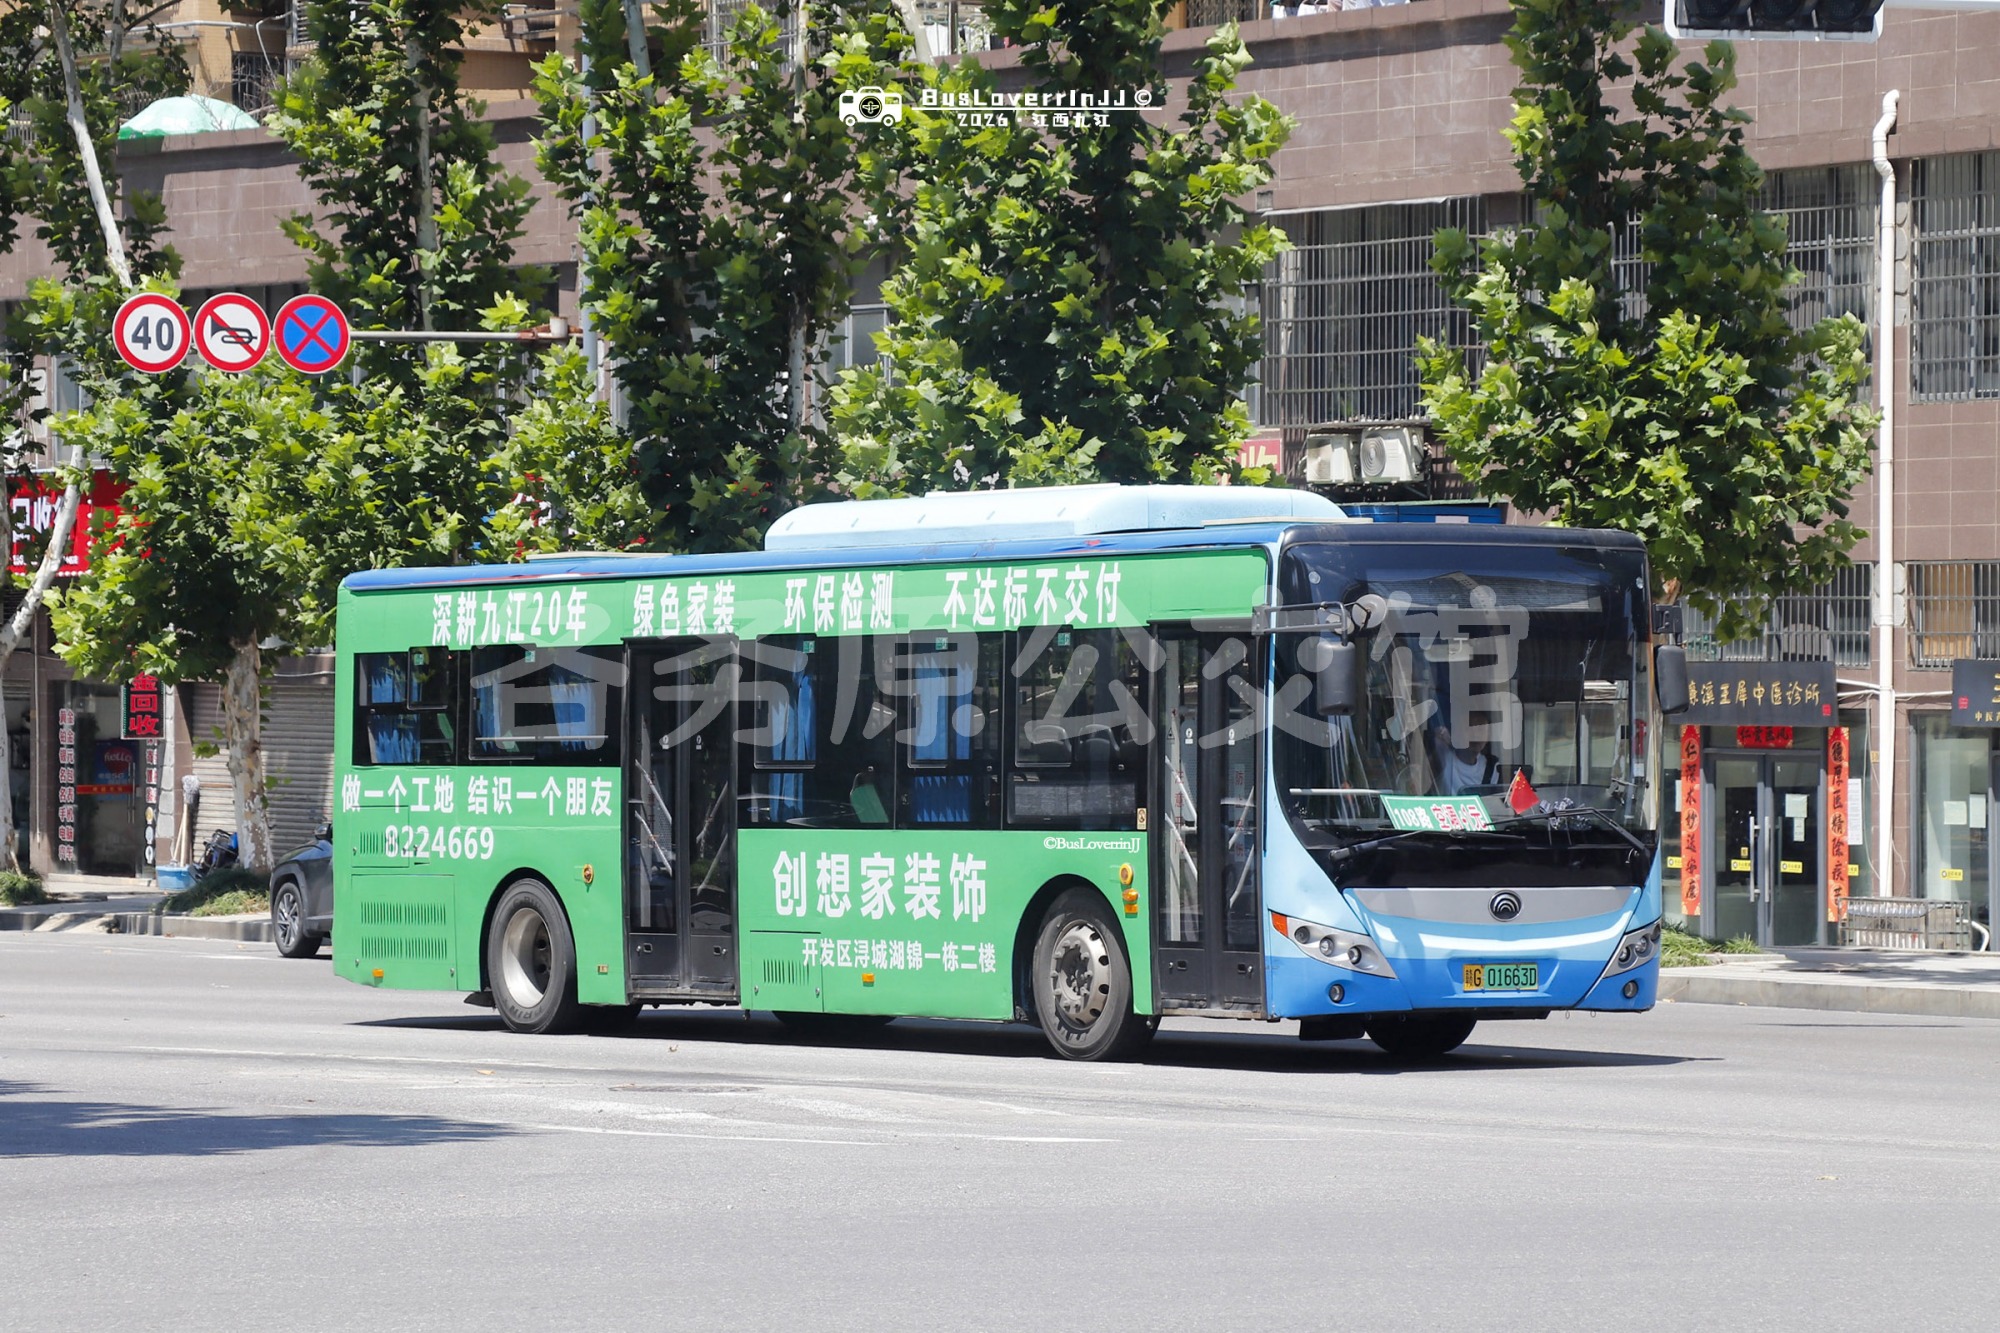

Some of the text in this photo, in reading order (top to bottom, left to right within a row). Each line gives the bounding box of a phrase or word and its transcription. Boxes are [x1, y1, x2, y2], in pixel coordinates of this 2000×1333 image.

[131, 316, 174, 352] 40
[432, 562, 1122, 646] 深耕九江20年 绿色家装 环保检测 不达标不交付
[342, 774, 455, 814] 做一个工地
[467, 776, 613, 817] 结识一个朋友
[1394, 806, 1434, 829] 108路
[384, 825, 495, 860] 8224669
[772, 850, 988, 923] 创想家装饰
[802, 938, 997, 974] 开发区浔城湖锦一栋二楼
